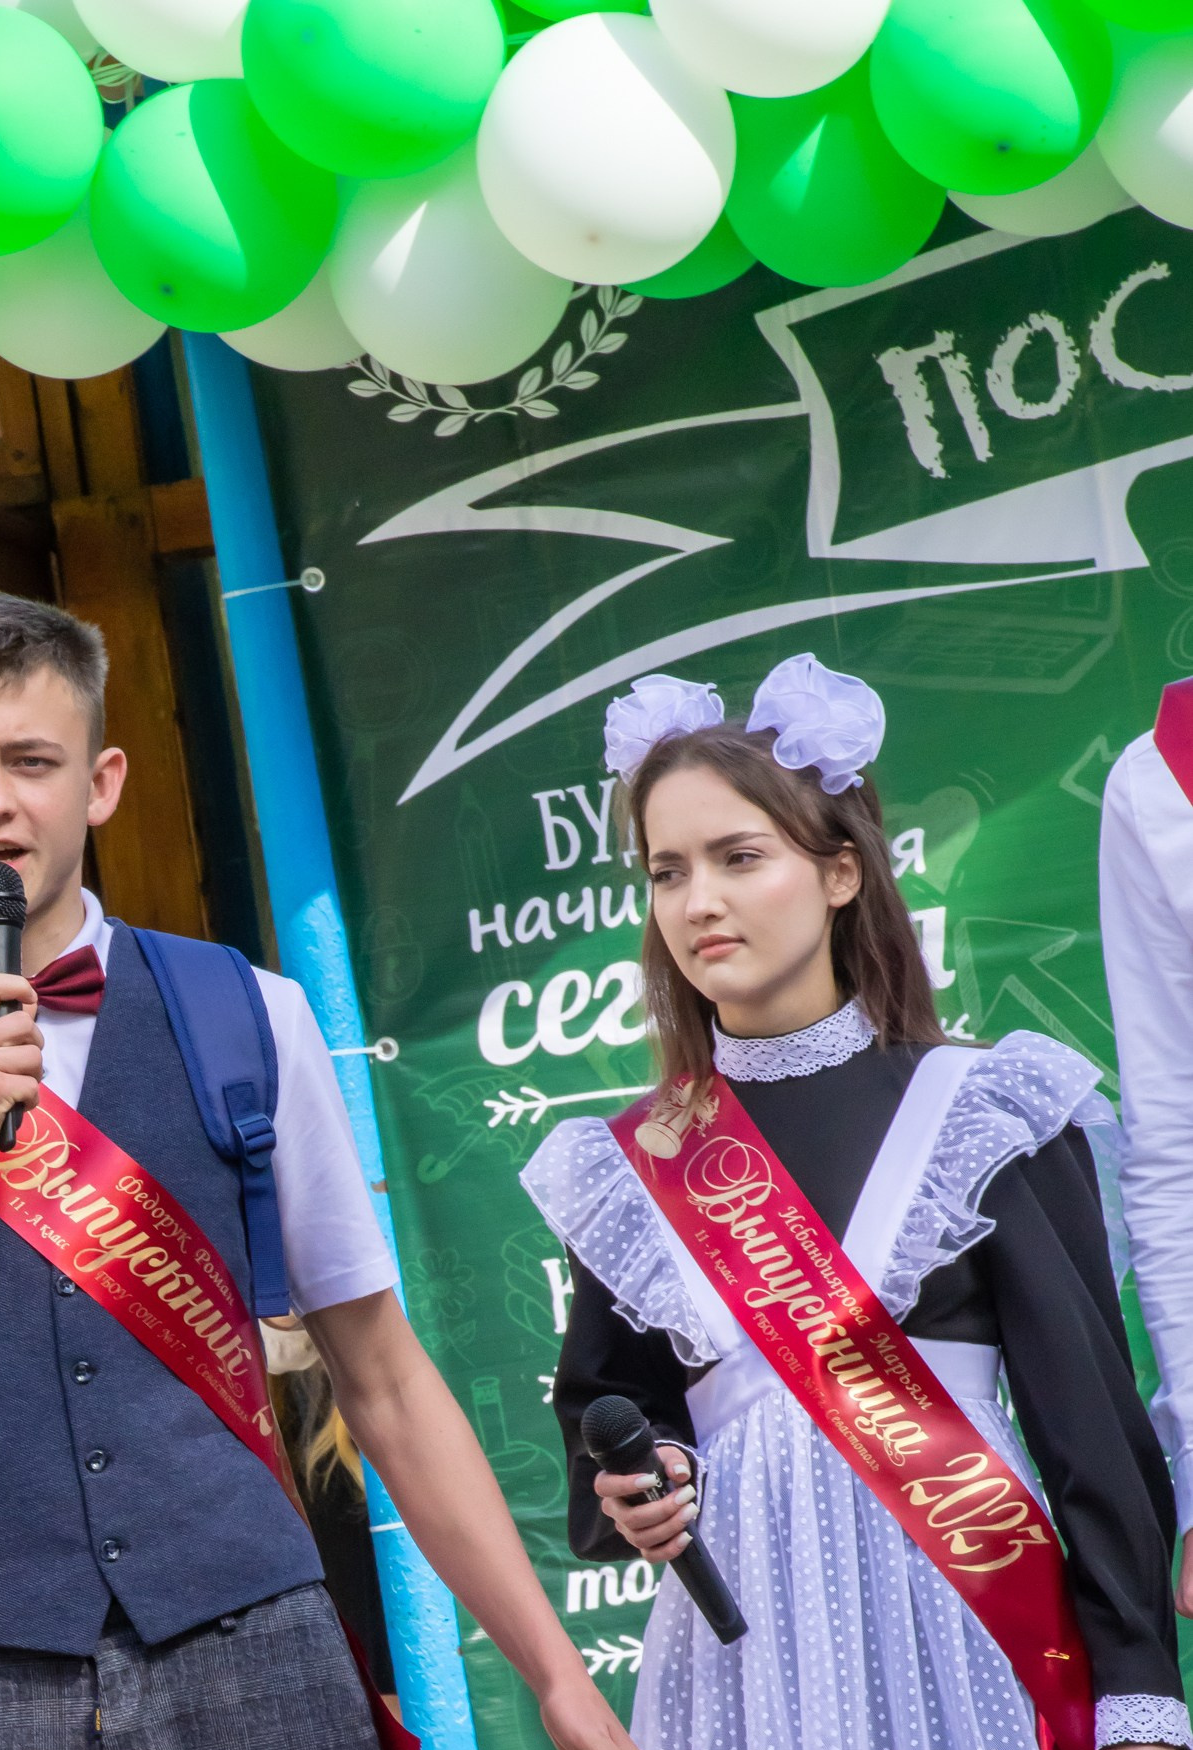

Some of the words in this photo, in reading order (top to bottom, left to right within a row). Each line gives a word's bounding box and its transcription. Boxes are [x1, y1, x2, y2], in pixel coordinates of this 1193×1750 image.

[39, 1224, 71, 1250] класс
[94, 1270, 133, 1300] ГБОУ
[128, 1302, 163, 1331] СОШ
[115, 1175, 192, 1254] Федорук
[194, 1247, 236, 1307] Роман
[714, 1257, 739, 1286] класс
[684, 1135, 929, 1467] Выпускница
[900, 1452, 1052, 1573] 2023
[778, 1205, 871, 1328] Исбандиярова
[869, 1331, 934, 1411] Марьям
[752, 1311, 783, 1343] ГБОУ
[776, 1345, 805, 1374] СОШ
[824, 1407, 880, 1472] Севастополь
